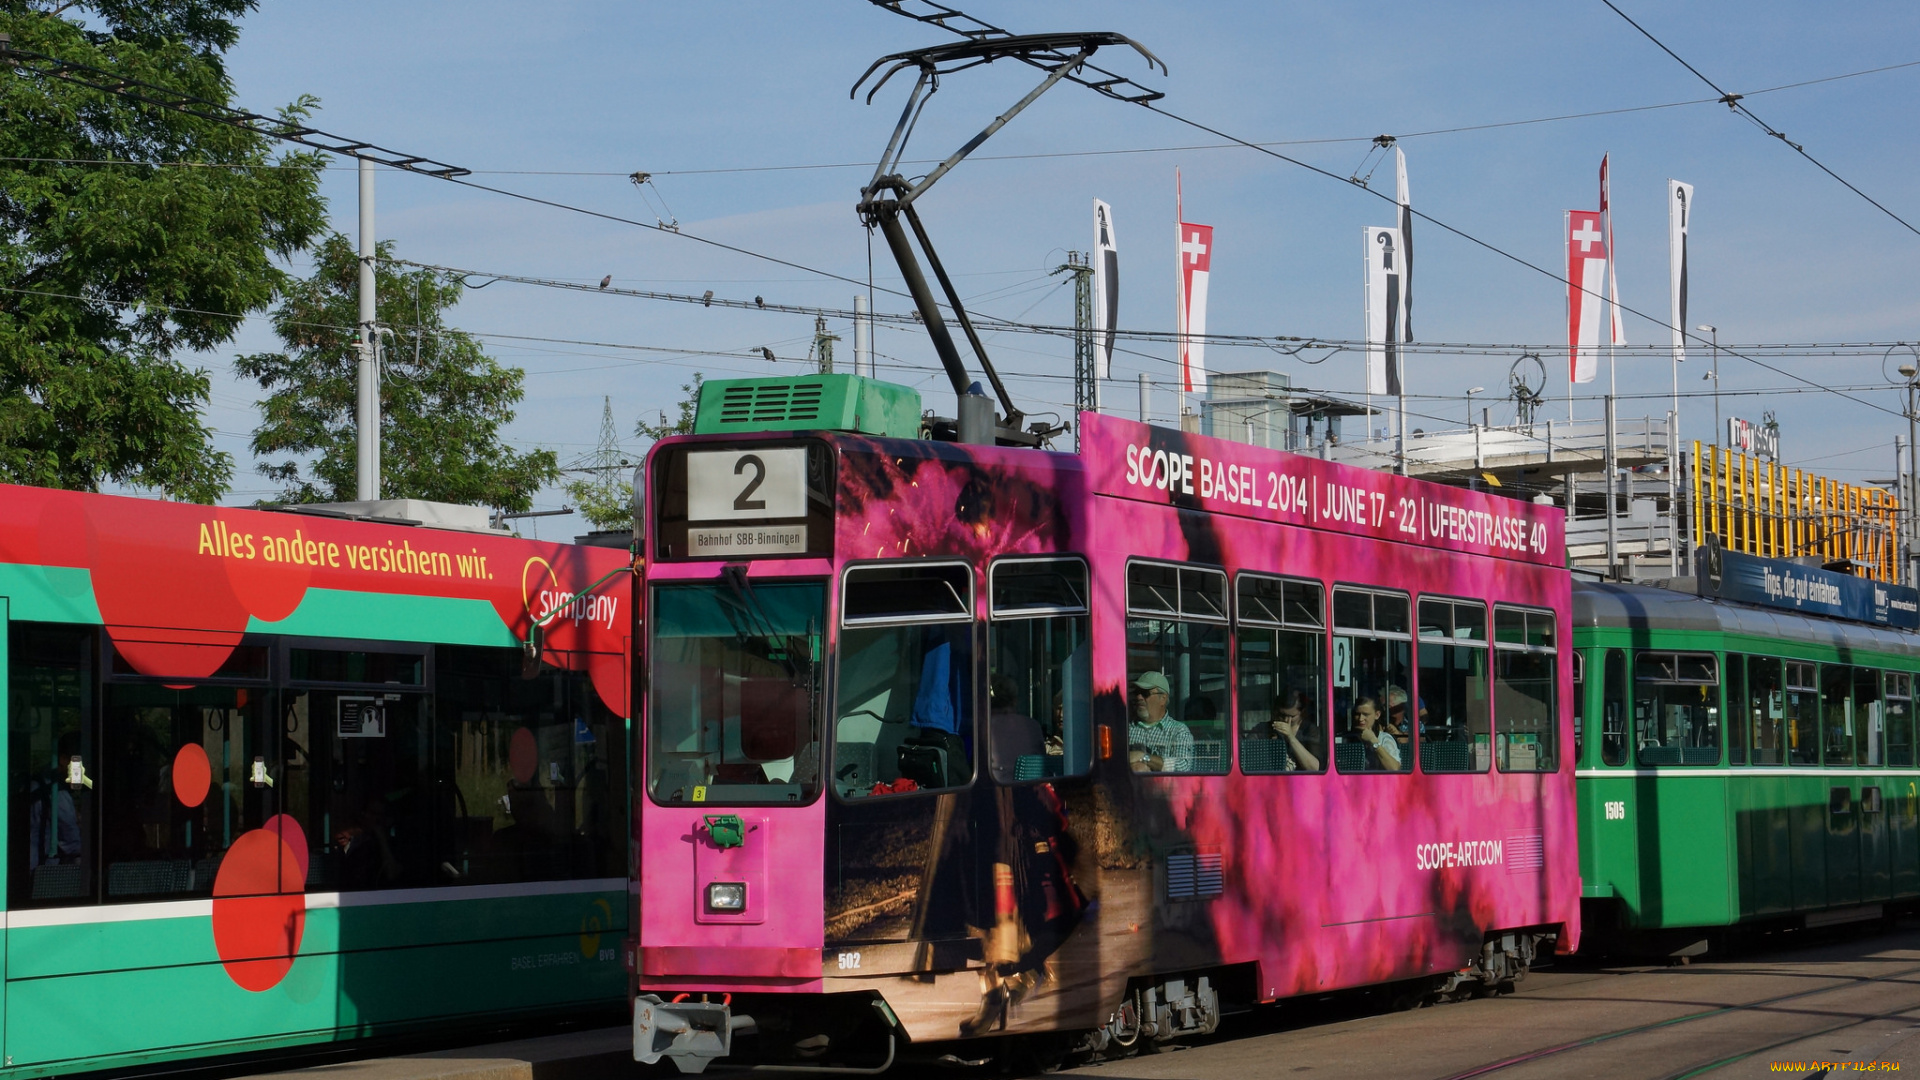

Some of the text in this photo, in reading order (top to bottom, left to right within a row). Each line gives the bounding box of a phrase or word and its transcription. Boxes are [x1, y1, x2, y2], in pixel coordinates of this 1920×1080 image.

[733, 454, 766, 511] 2
[1126, 443, 1194, 495] SCOPE
[1201, 458, 1262, 507] BASEL
[1267, 471, 1308, 515] 2014
[1322, 482, 1366, 525] JUNE
[1370, 491, 1385, 528] 17
[1399, 497, 1417, 534] 22
[1429, 502, 1526, 552] UFERSTRASSE
[1530, 521, 1547, 555] 40
[198, 519, 494, 580] Alles andere versichern wir.
[698, 532, 800, 547] Bahnhof SBB-Binningen
[531, 589, 618, 630] sympany
[1338, 642, 1346, 682] 2
[696, 790, 702, 799] 3
[1604, 801, 1625, 820] 1505
[1416, 840, 1503, 871] SCOPE-ART.COM
[512, 955, 536, 970] BASEL
[599, 949, 616, 961] BVB
[838, 952, 861, 969] 502
